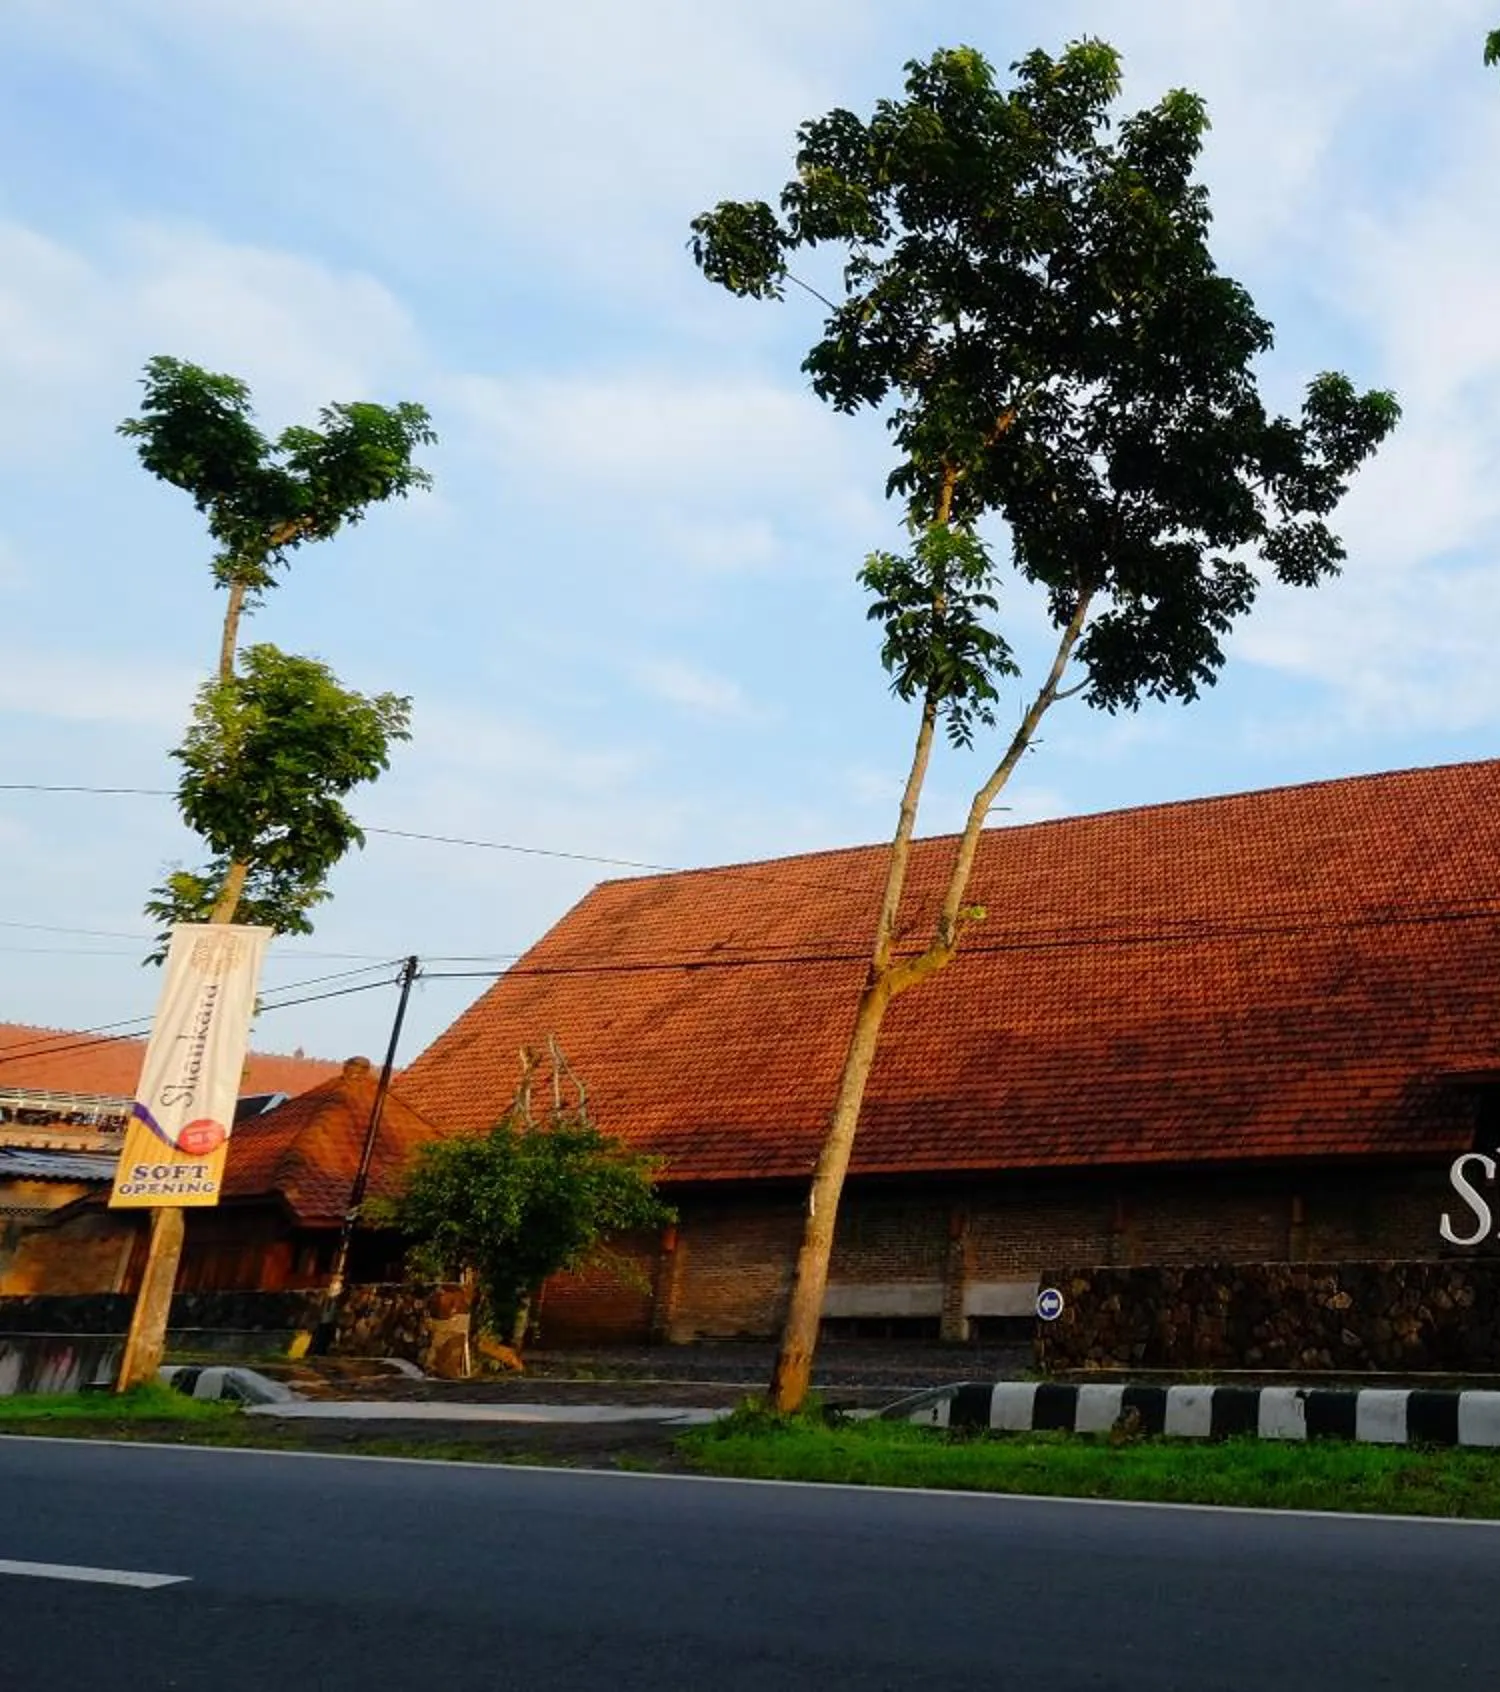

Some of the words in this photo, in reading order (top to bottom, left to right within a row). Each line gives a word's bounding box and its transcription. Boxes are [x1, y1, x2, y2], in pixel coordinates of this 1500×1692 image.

[159, 984, 219, 1109] Shankara
[131, 1164, 209, 1181] SOFT
[118, 1181, 217, 1196] OPENING
